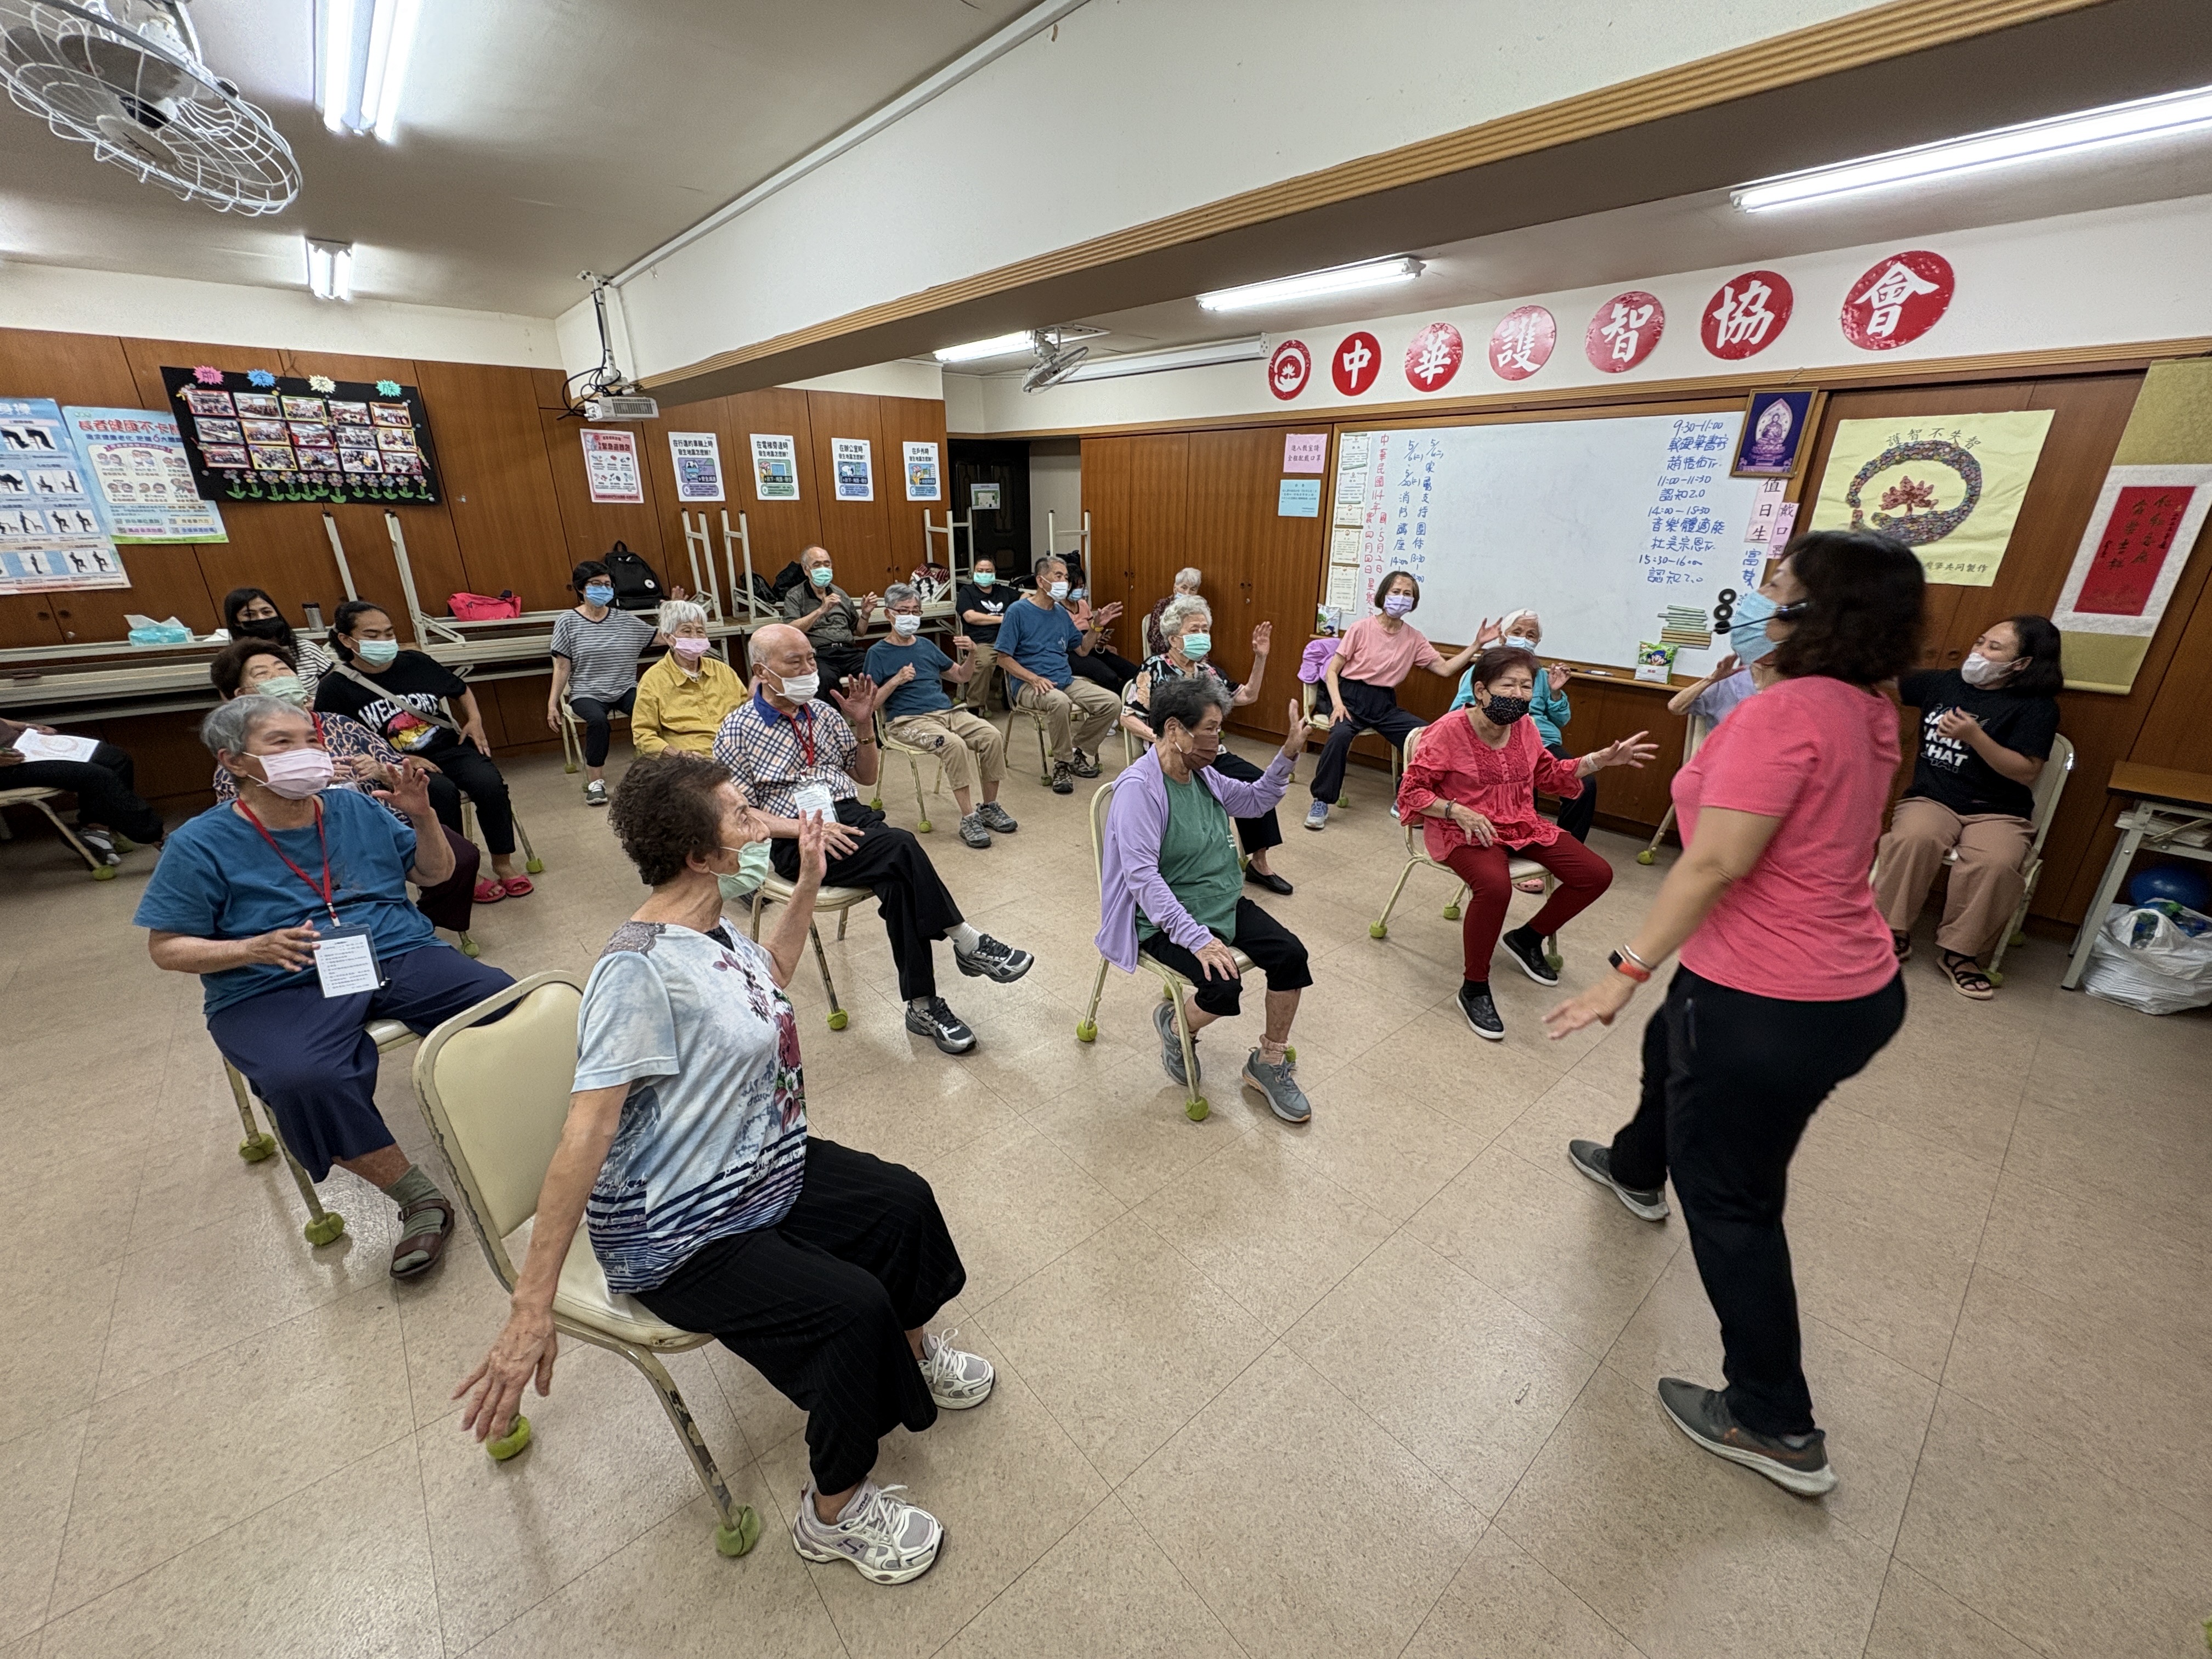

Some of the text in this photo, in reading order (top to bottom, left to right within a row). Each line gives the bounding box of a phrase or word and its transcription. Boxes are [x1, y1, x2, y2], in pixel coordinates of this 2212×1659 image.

[1341, 262, 1939, 390] 中華護智協會
[1886, 427, 1982, 450] 護智不失智
[1659, 488, 1706, 501] 認知2.0
[1749, 477, 1781, 541] 值日生
[1652, 516, 1725, 534] 音樂體適能
[1768, 503, 1795, 558] 戴口罩
